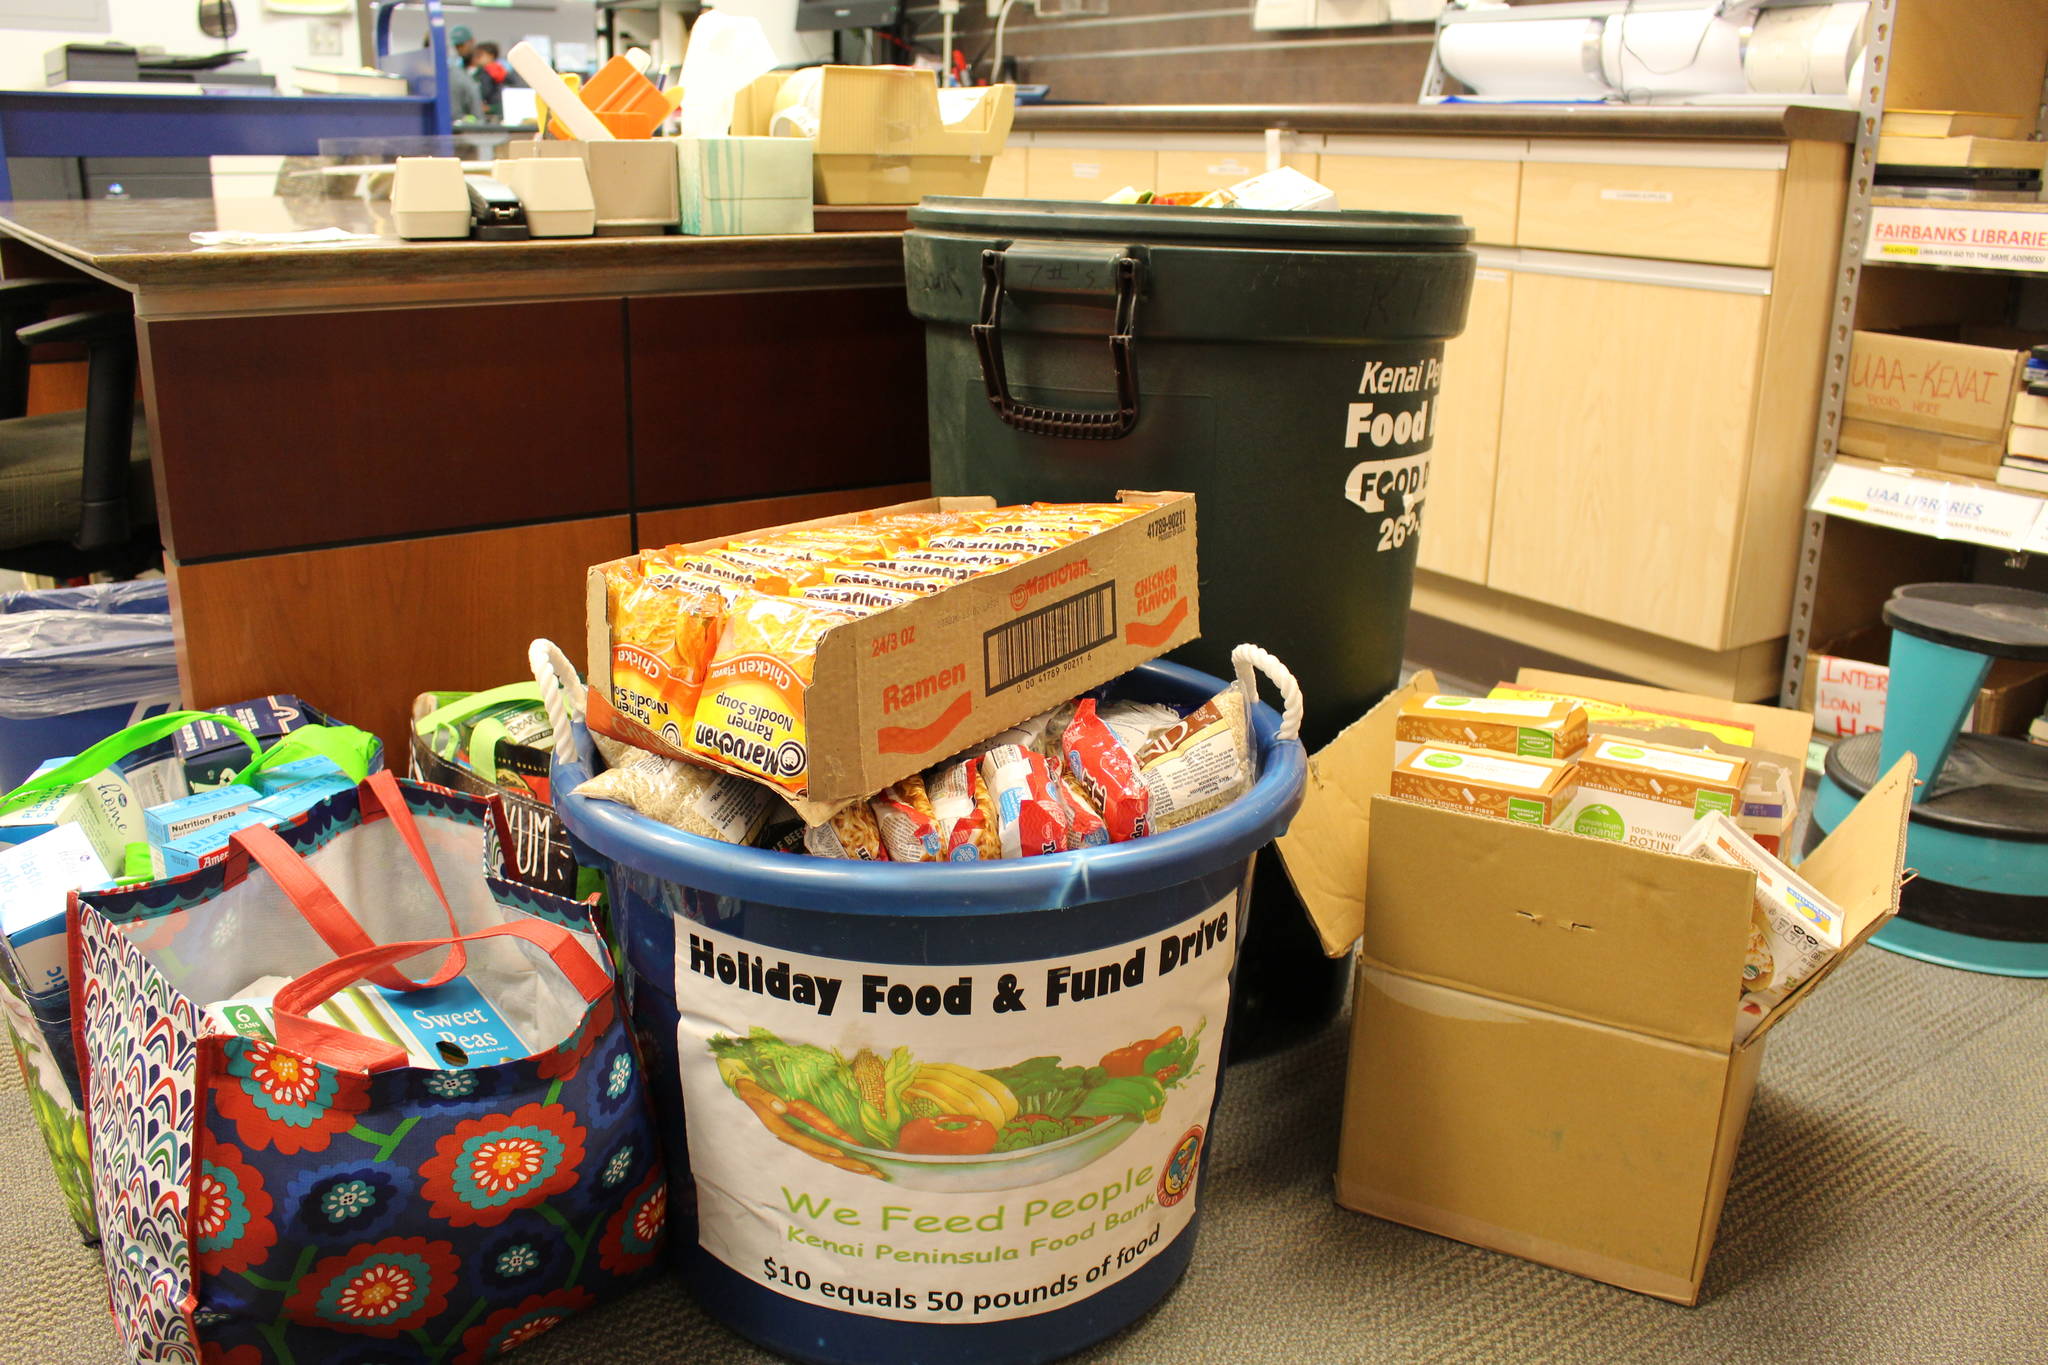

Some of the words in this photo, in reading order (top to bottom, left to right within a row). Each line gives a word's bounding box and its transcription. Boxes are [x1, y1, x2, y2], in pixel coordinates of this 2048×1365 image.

[1875, 222, 1967, 242] FAIRBANKS
[1966, 251, 1976, 259] TO
[1358, 360, 1424, 394] Kenai
[1345, 401, 1428, 448] Food
[1360, 466, 1420, 501] FOOD
[1866, 486, 1900, 503] UAA
[1905, 494, 1984, 516] LIBRRIES
[1030, 557, 1090, 595] Maruchan
[1134, 564, 1177, 599] CHICKEN
[1136, 584, 1177, 617] FLAVOR
[871, 633, 901, 657] 24/3
[900, 625, 916, 648] OZ
[711, 664, 737, 680] Flavor
[739, 660, 791, 690] Chicken
[716, 691, 748, 715] Soup
[883, 663, 966, 714] Ramen
[1820, 690, 1861, 714] LOAN
[614, 699, 650, 725] Ramen
[630, 691, 669, 716] Noodle
[749, 704, 794, 732] Noodle
[727, 713, 773, 742] Ramen
[696, 723, 780, 776] Maruchan
[97, 783, 127, 836] home
[171, 814, 211, 833] Nutrition
[211, 809, 237, 825] Facts
[1578, 823, 1621, 840] organic
[1631, 825, 1653, 836] 100%
[203, 851, 229, 868] Amer
[689, 933, 842, 1016] Holiday
[861, 975, 973, 1016] Food
[992, 973, 1026, 1012] &
[1046, 947, 1146, 1008] Fund
[1158, 910, 1229, 976] Drive
[235, 1007, 250, 1023] 6
[237, 1019, 261, 1030] CANS
[411, 1007, 488, 1030] Sweet
[436, 1030, 498, 1049] Peas
[780, 1184, 862, 1229] We
[880, 1205, 1006, 1235] Feed
[1022, 1162, 1156, 1226] People
[786, 1225, 864, 1258] Kenai
[874, 1245, 1020, 1266] Peninsula
[1029, 1225, 1096, 1258] Food
[1102, 1192, 1156, 1232] Bank
[763, 1256, 812, 1292] $10
[819, 1278, 918, 1311] equals
[926, 1290, 965, 1313] 50
[972, 1273, 1078, 1315] pounds
[1083, 1252, 1113, 1284] of
[1115, 1224, 1161, 1266] food
